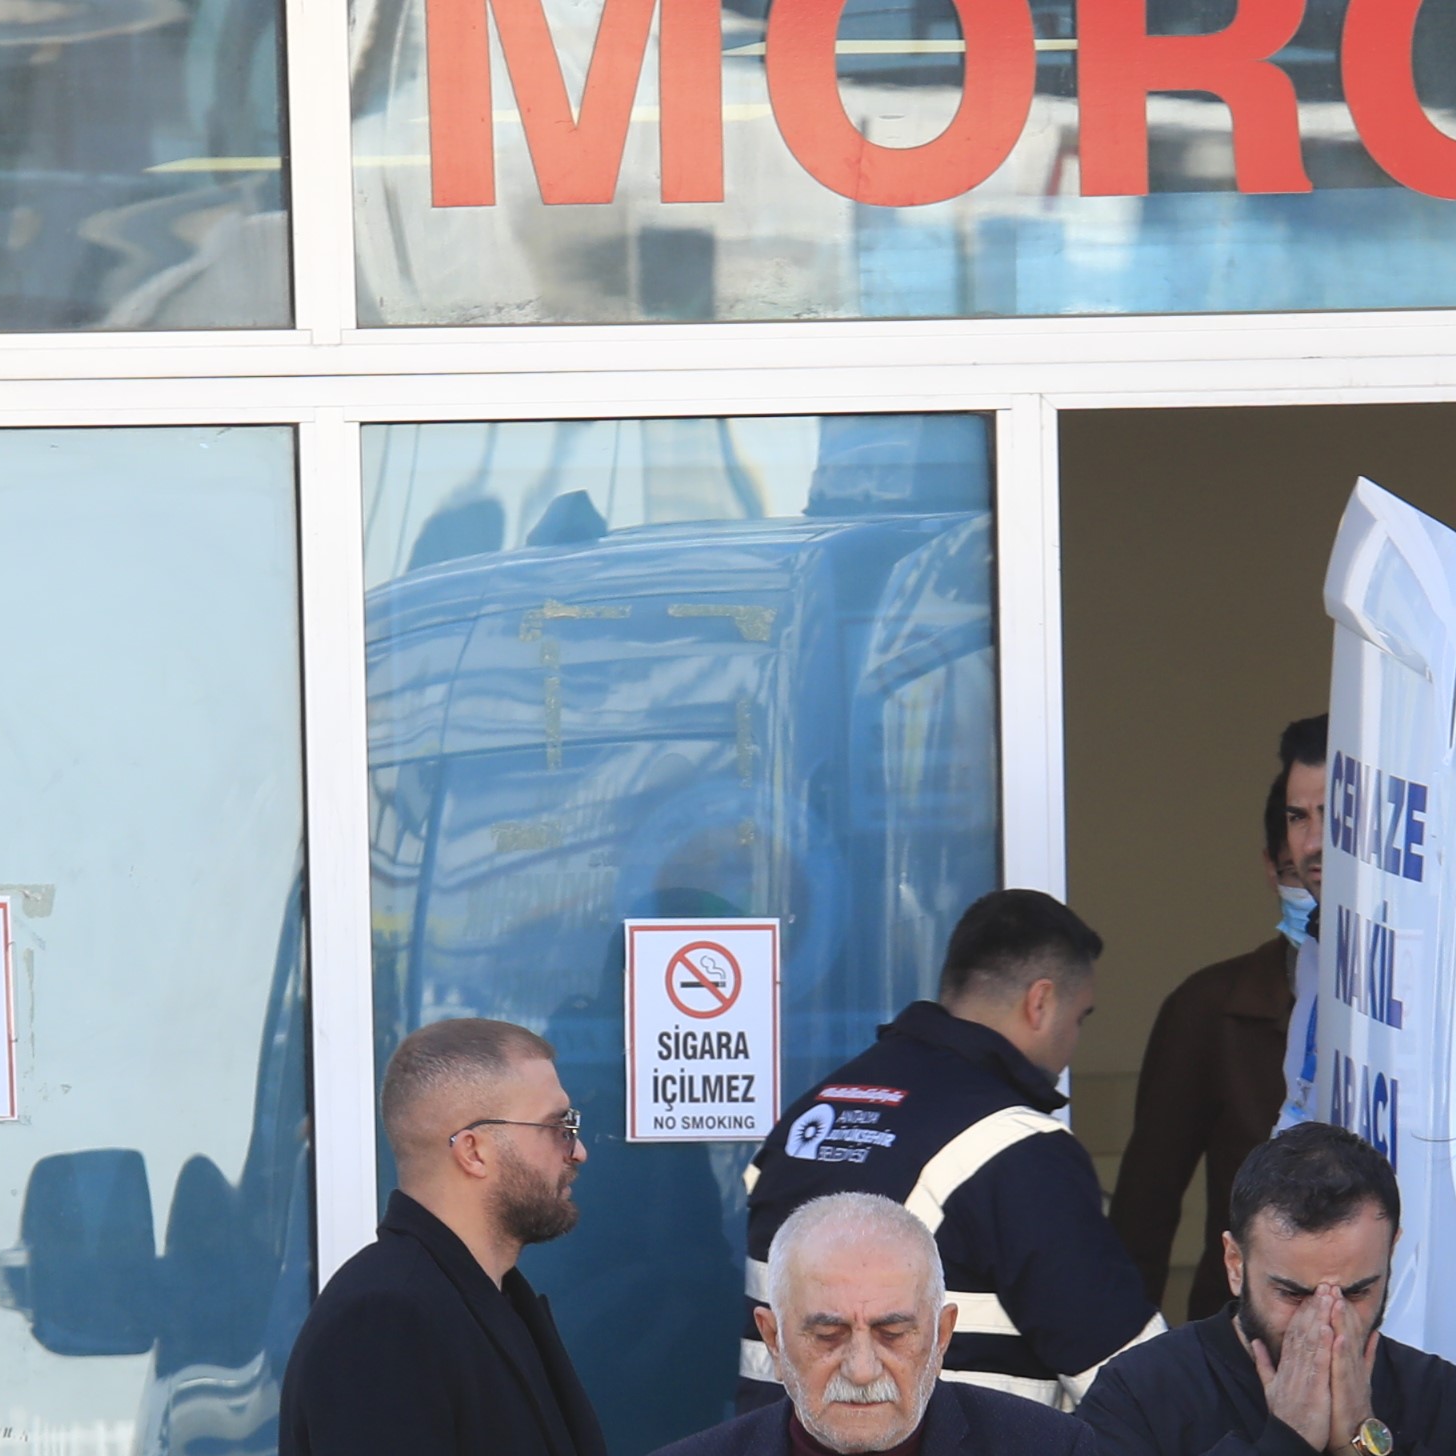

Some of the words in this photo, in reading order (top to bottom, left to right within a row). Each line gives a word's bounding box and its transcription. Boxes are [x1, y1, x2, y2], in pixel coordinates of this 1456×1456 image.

[1329, 750, 1428, 883] CENAZE
[1335, 900, 1403, 1030] NAKİL
[657, 1025, 750, 1061] SİGARA
[653, 1068, 756, 1112] İÇİLMEZ
[653, 1116, 676, 1130] NO
[681, 1115, 756, 1130] SMOKING
